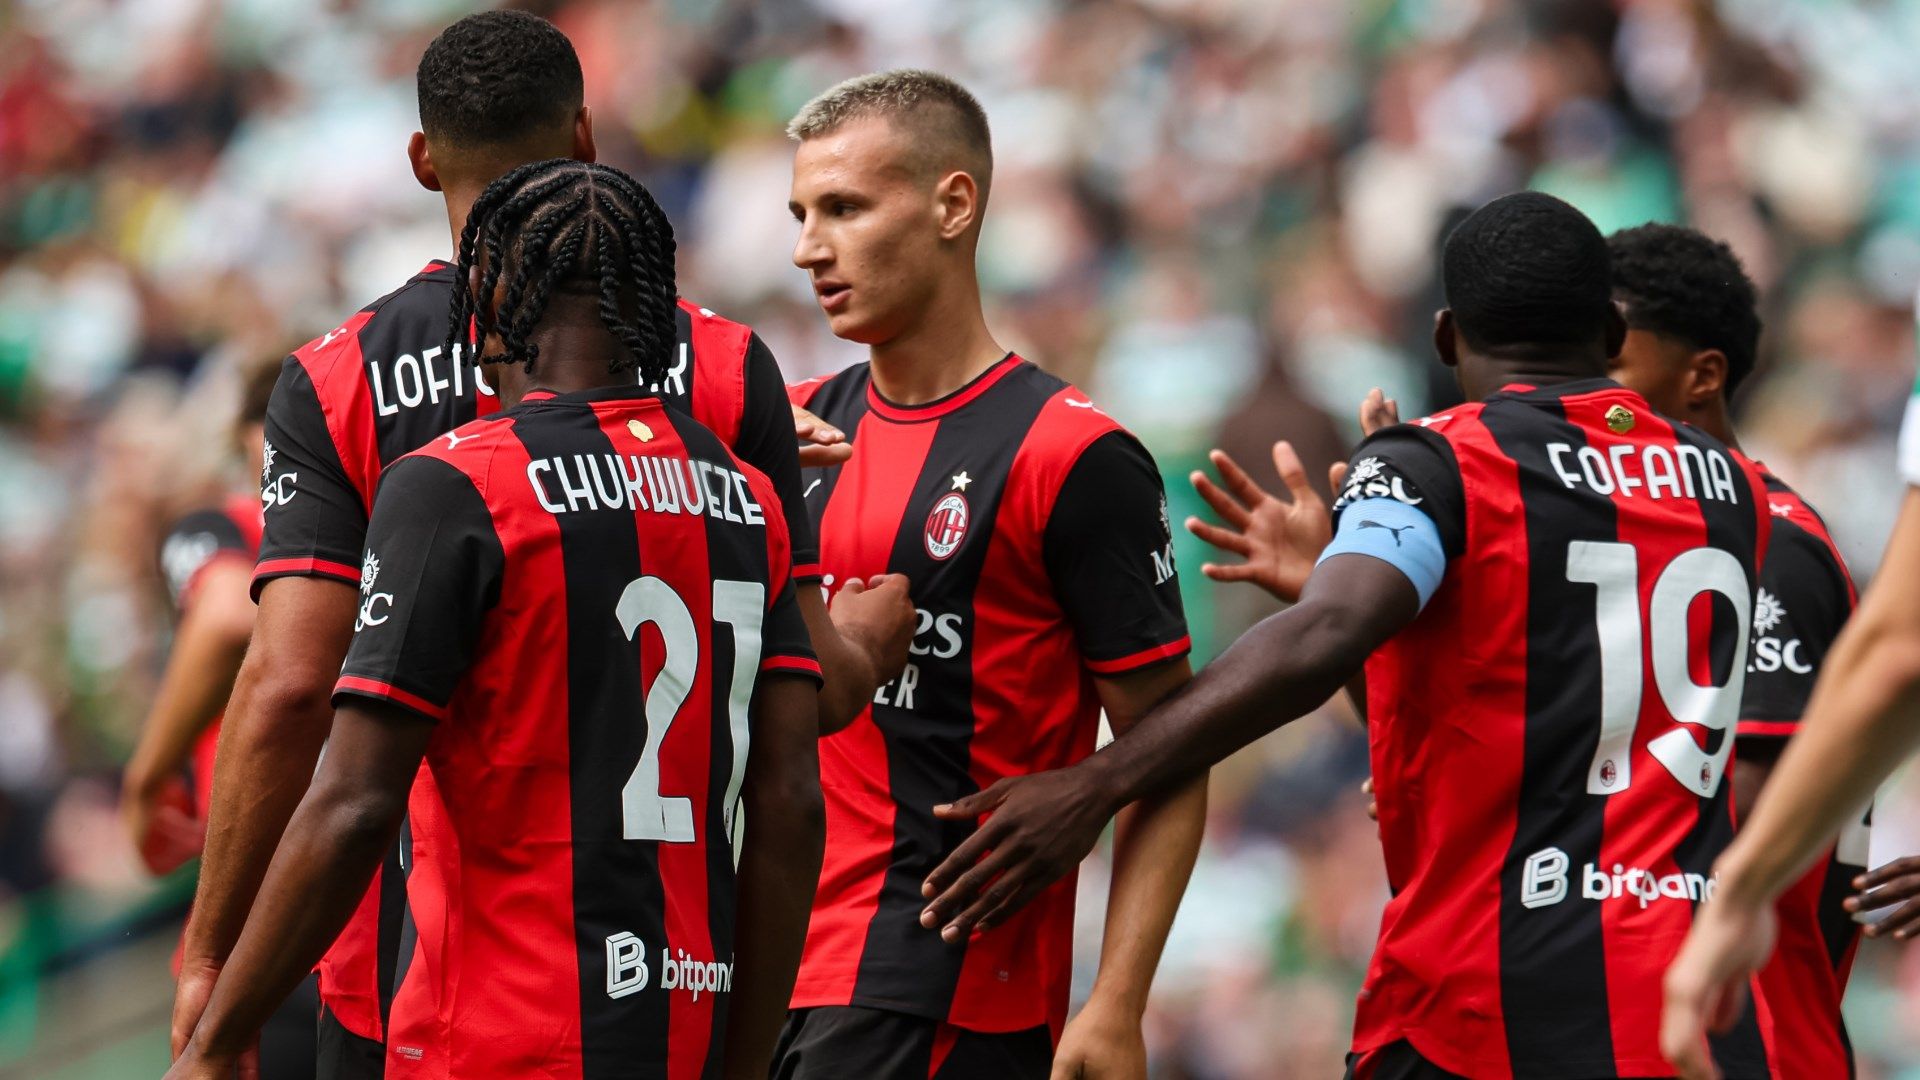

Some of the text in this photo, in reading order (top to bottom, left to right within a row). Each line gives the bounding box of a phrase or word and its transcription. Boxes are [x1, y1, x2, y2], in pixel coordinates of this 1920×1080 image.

[261, 472, 298, 512] SC
[526, 454, 766, 525] CHUKWUEZE
[1546, 442, 1738, 505] FOFANA
[1565, 540, 1751, 798] 19
[1747, 636, 1813, 674] SC
[1521, 847, 1569, 909] B
[606, 931, 649, 1000] B
